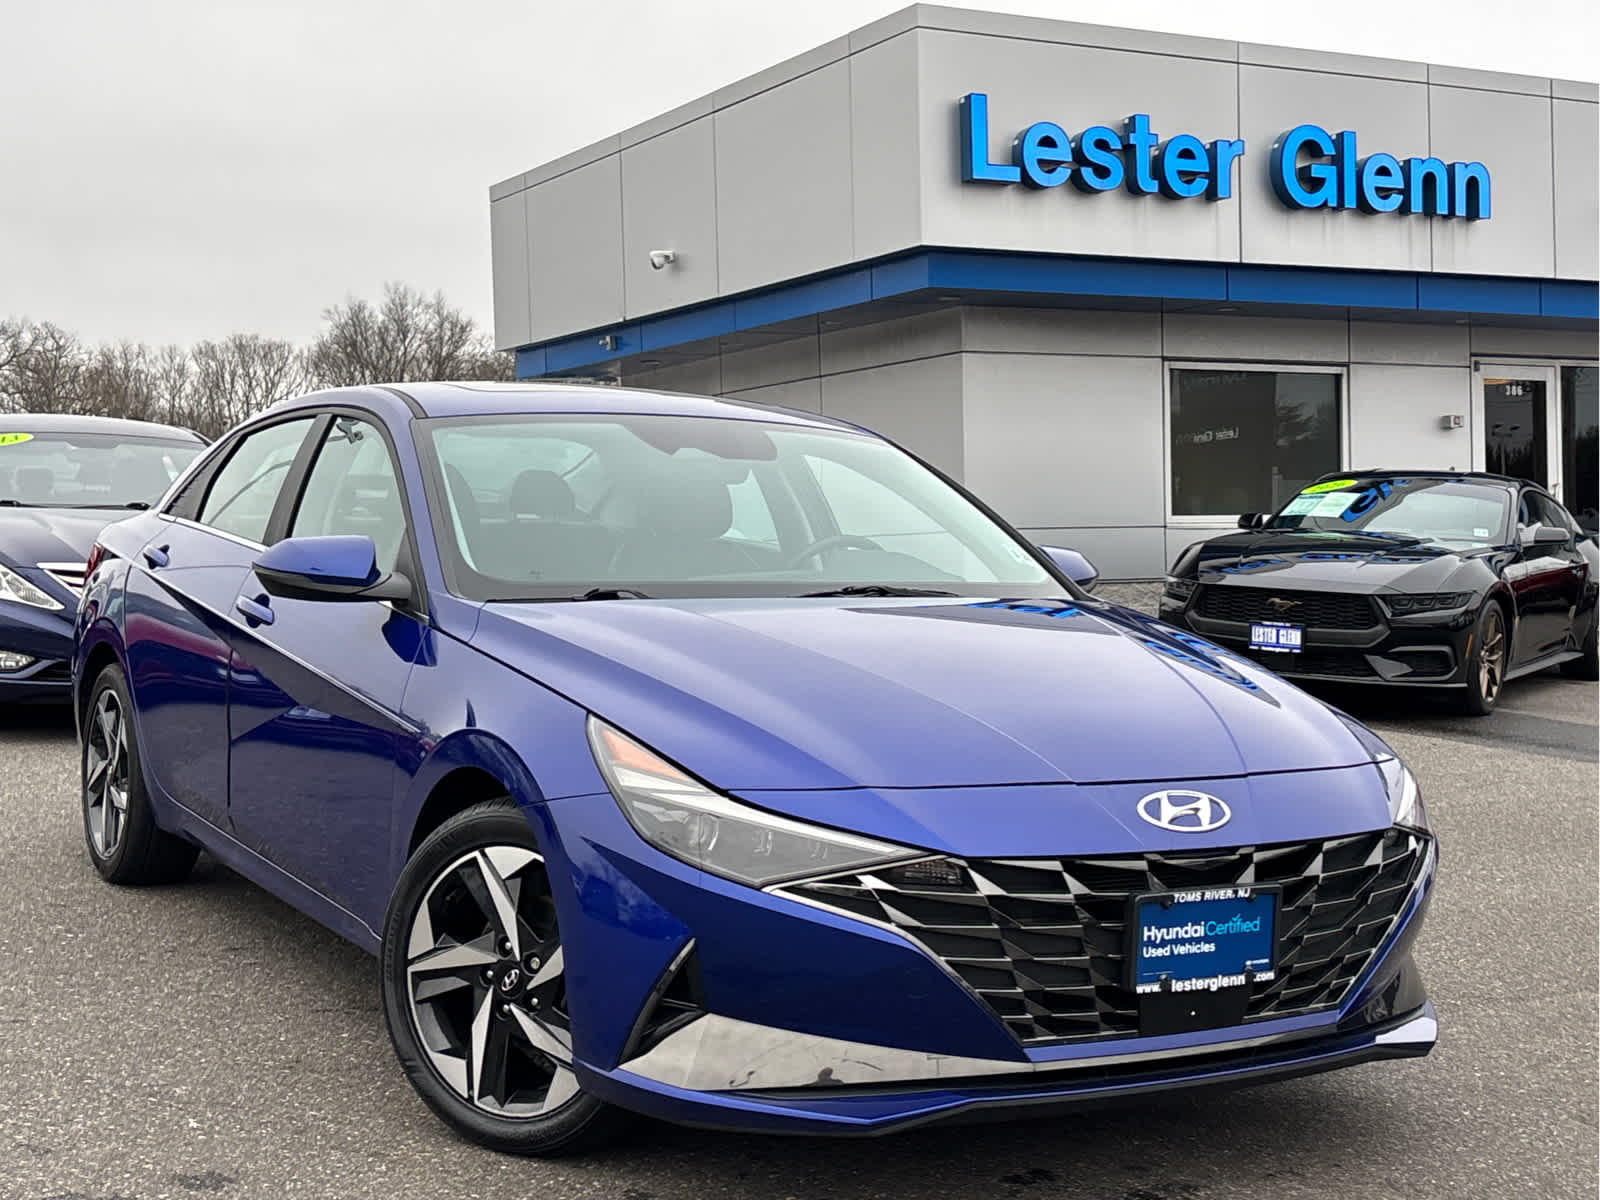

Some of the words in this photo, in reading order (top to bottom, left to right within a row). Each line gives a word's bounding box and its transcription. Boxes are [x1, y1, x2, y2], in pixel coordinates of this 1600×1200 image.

[960, 92, 1245, 200] Lester
[1270, 124, 1492, 220] Glenn
[1251, 625, 1277, 643] LESTER
[1173, 893, 1201, 903] TOMS
[1237, 888, 1250, 898] NJ
[1143, 921, 1205, 943] Hyundai
[1205, 914, 1261, 936] Certified
[1143, 945, 1171, 957] Used
[1172, 942, 1216, 954] Vehicles
[1171, 974, 1246, 992] lesterglenn
[1253, 971, 1275, 982] .com
